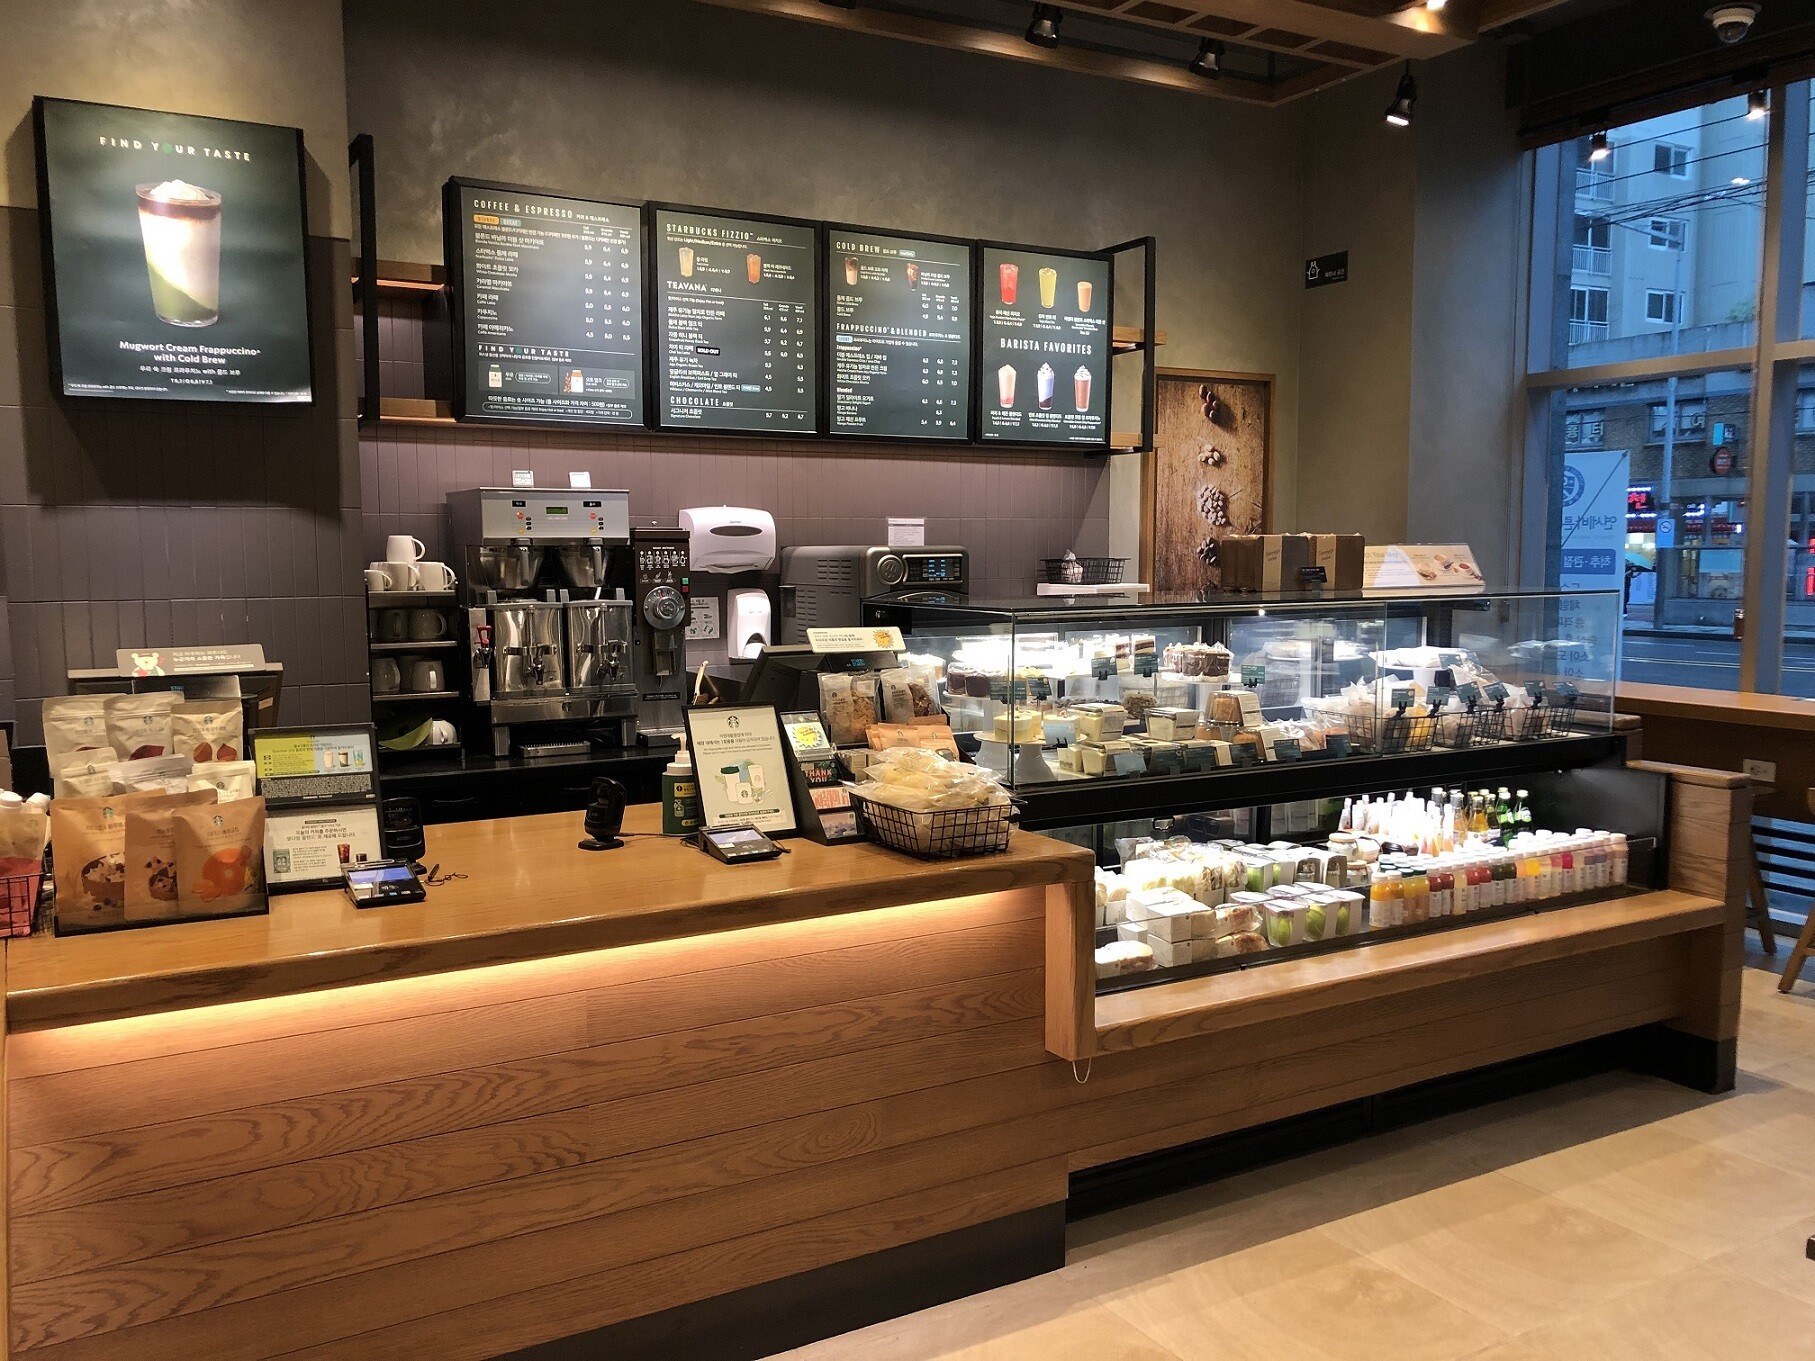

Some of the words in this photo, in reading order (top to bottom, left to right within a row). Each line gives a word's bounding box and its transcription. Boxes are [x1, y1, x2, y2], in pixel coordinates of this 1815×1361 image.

[99, 136, 143, 149] FIND
[203, 148, 251, 162] TASTE
[474, 200, 509, 212] COFFEE
[514, 204, 520, 212] &
[526, 205, 572, 218] ESPRESSO
[667, 224, 718, 237] STARBUCKS
[837, 242, 856, 250] COLD
[860, 245, 880, 253] BREW
[896, 328, 927, 337] BLENDED
[120, 341, 164, 351] Mugwort
[166, 344, 197, 353] Cream
[1000, 338, 1039, 350] BARISTA
[1044, 341, 1092, 355] FAVORITES
[154, 353, 175, 362] with
[178, 354, 200, 363] Cold
[202, 356, 226, 364] Brew
[541, 349, 569, 357] TASTE
[670, 396, 719, 406] CHOCOLATE
[805, 769, 832, 777] THANK
